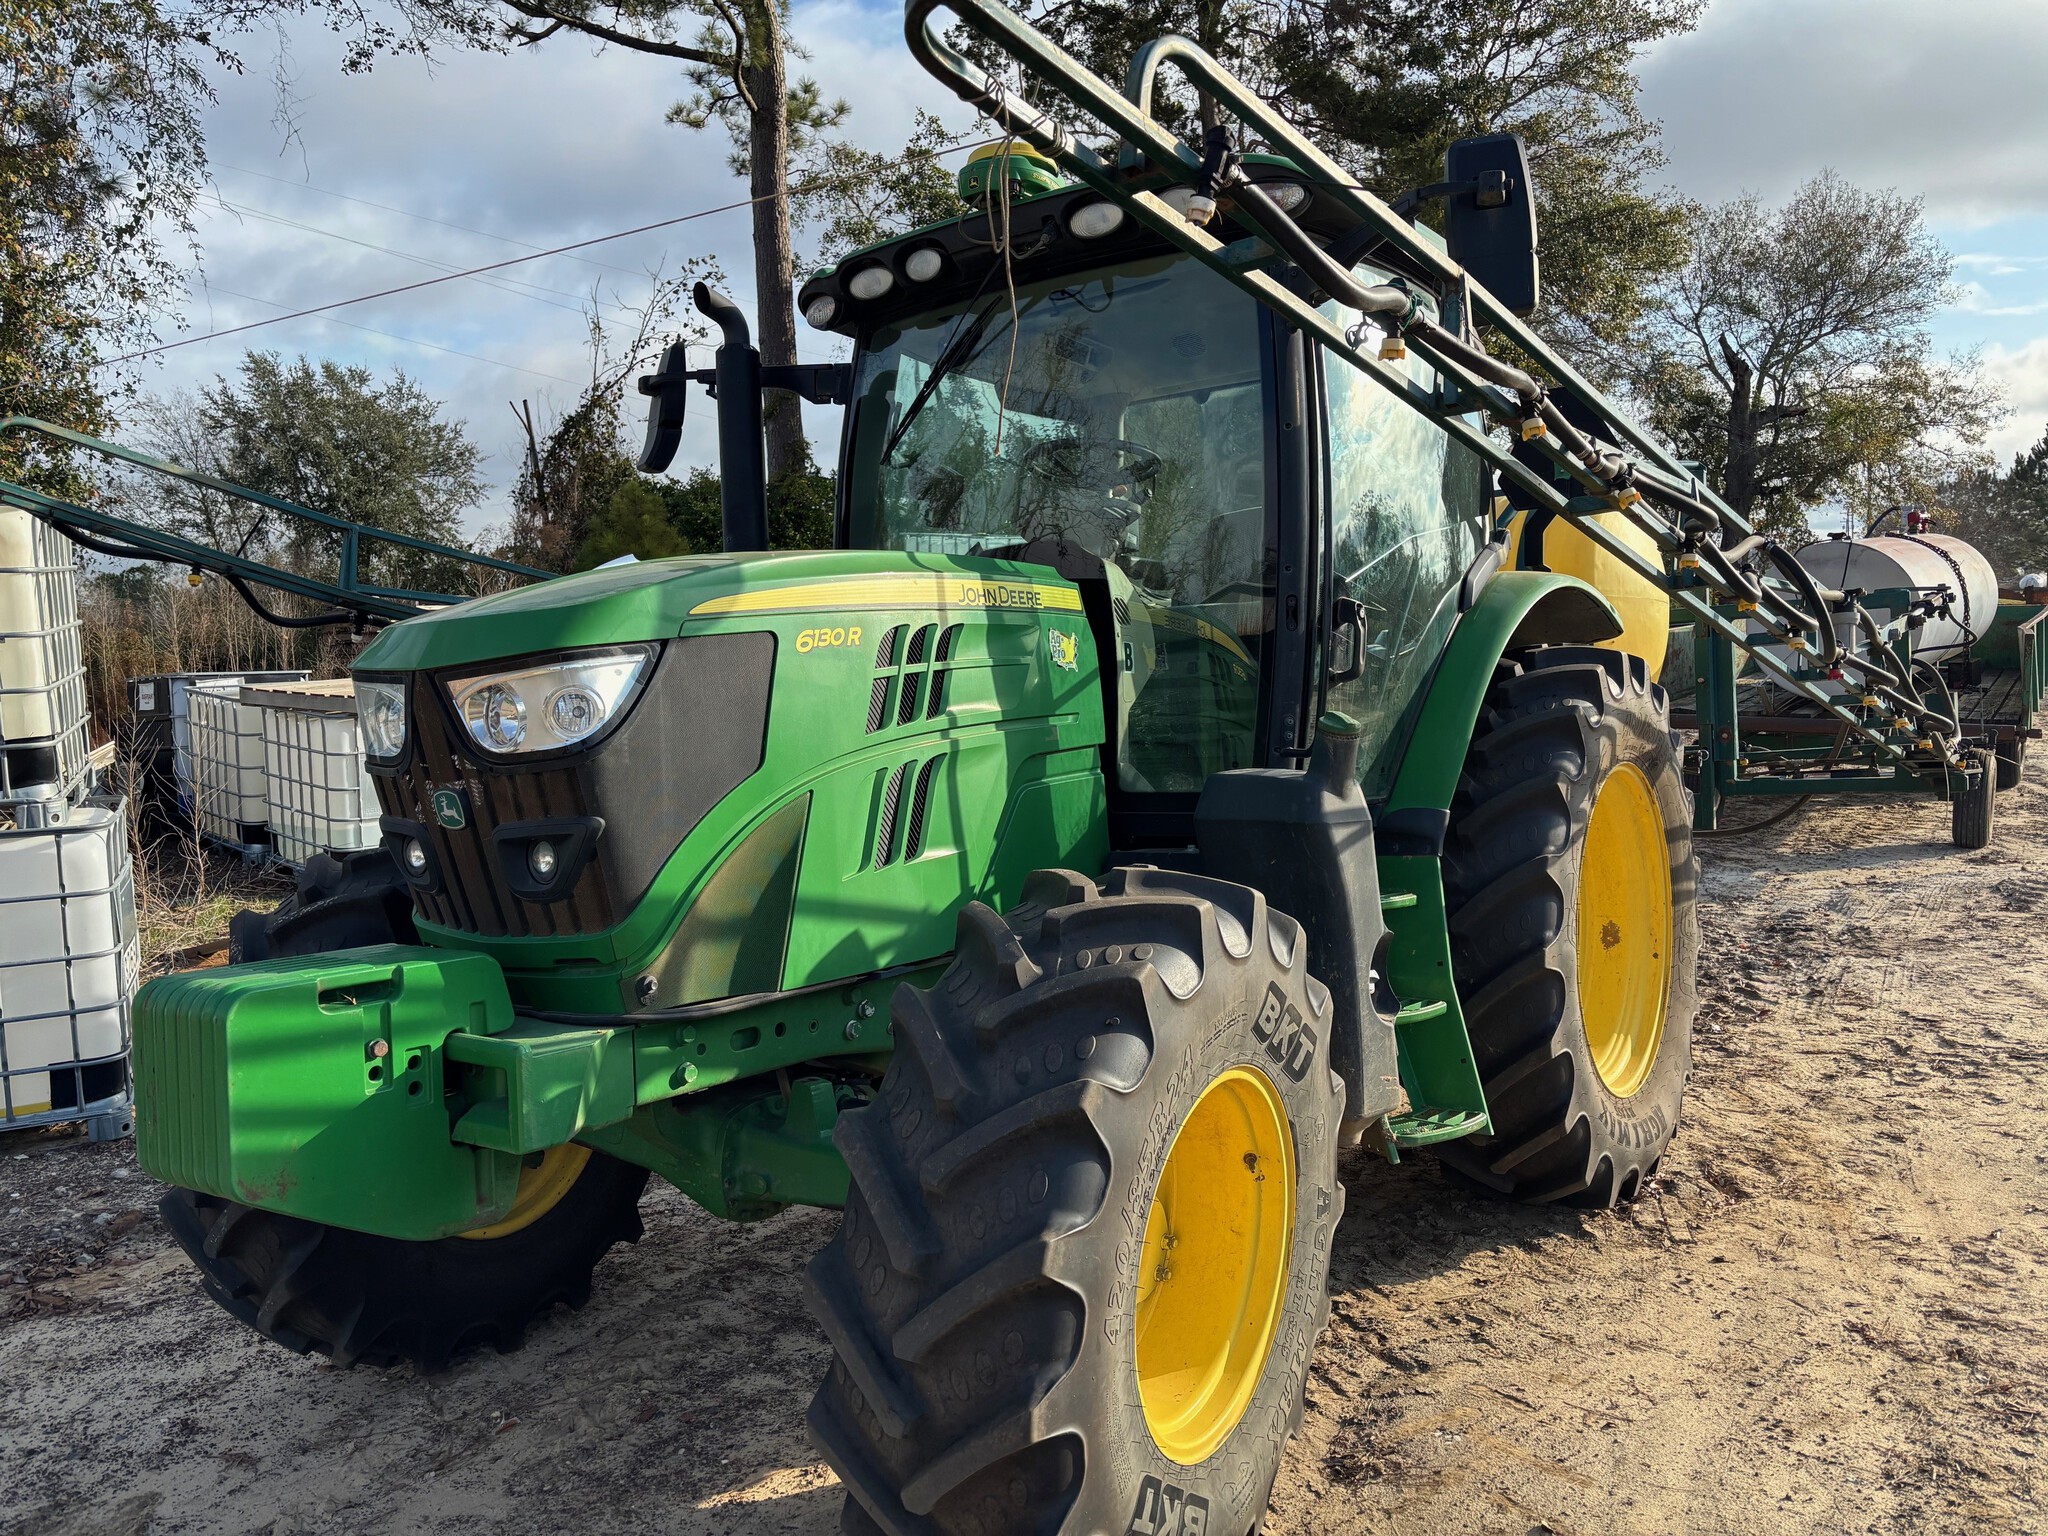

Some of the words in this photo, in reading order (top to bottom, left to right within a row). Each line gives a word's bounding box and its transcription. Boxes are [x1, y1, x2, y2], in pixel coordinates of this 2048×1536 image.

[958, 584, 998, 605] JOHN
[998, 585, 1043, 607] DEERE
[1123, 642, 1133, 672] B
[1250, 980, 1318, 1084] BKT
[1124, 1474, 1210, 1536] BKT
